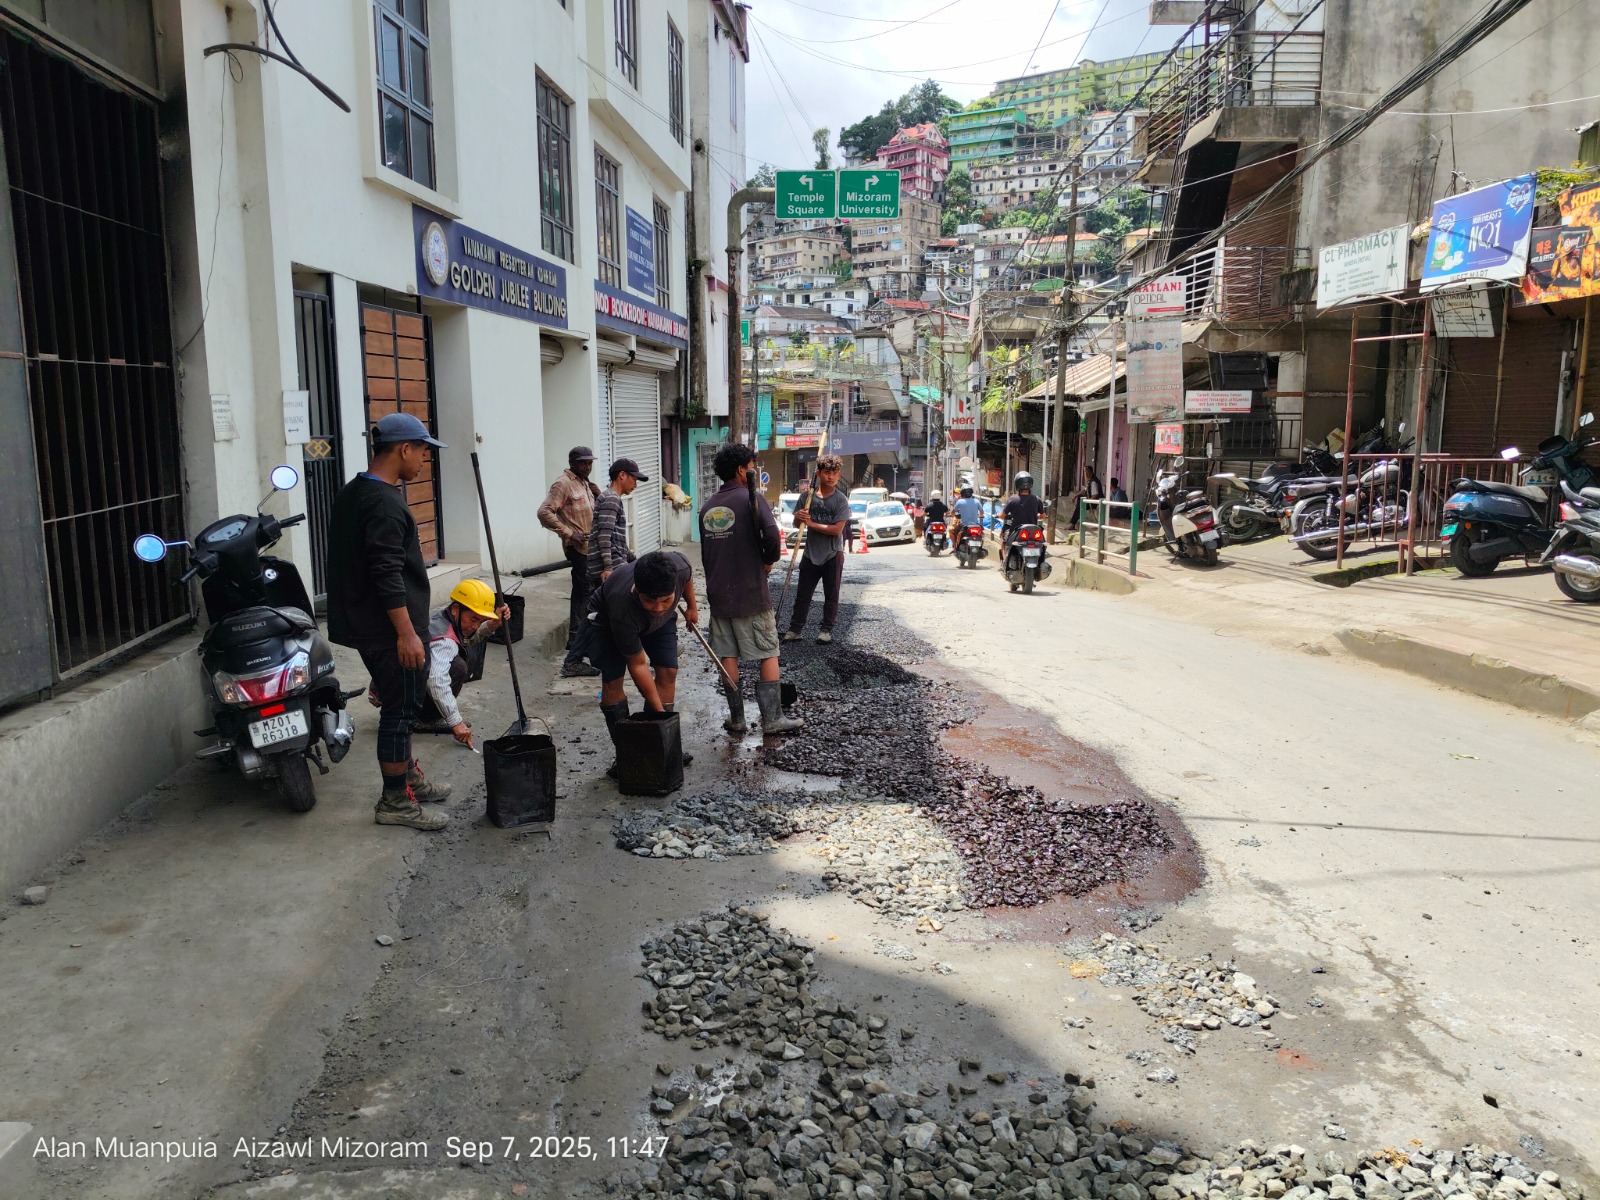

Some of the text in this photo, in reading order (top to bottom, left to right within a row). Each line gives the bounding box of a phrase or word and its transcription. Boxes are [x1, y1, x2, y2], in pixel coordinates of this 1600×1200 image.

[787, 192, 825, 203] Temple
[846, 192, 891, 202] Mizoram
[787, 205, 825, 216] Square
[841, 204, 895, 216] University
[1337, 230, 1398, 260] PHARMACY
[1469, 269, 1489, 279] MART
[450, 261, 567, 319] GOLDEN JUBILEE BUILDING
[1133, 293, 1167, 305] OPTICAL
[231, 620, 267, 632] SUZUKI
[246, 656, 272, 666] SUZUKI
[262, 715, 291, 731] MZ01
[262, 725, 299, 744] R6318
